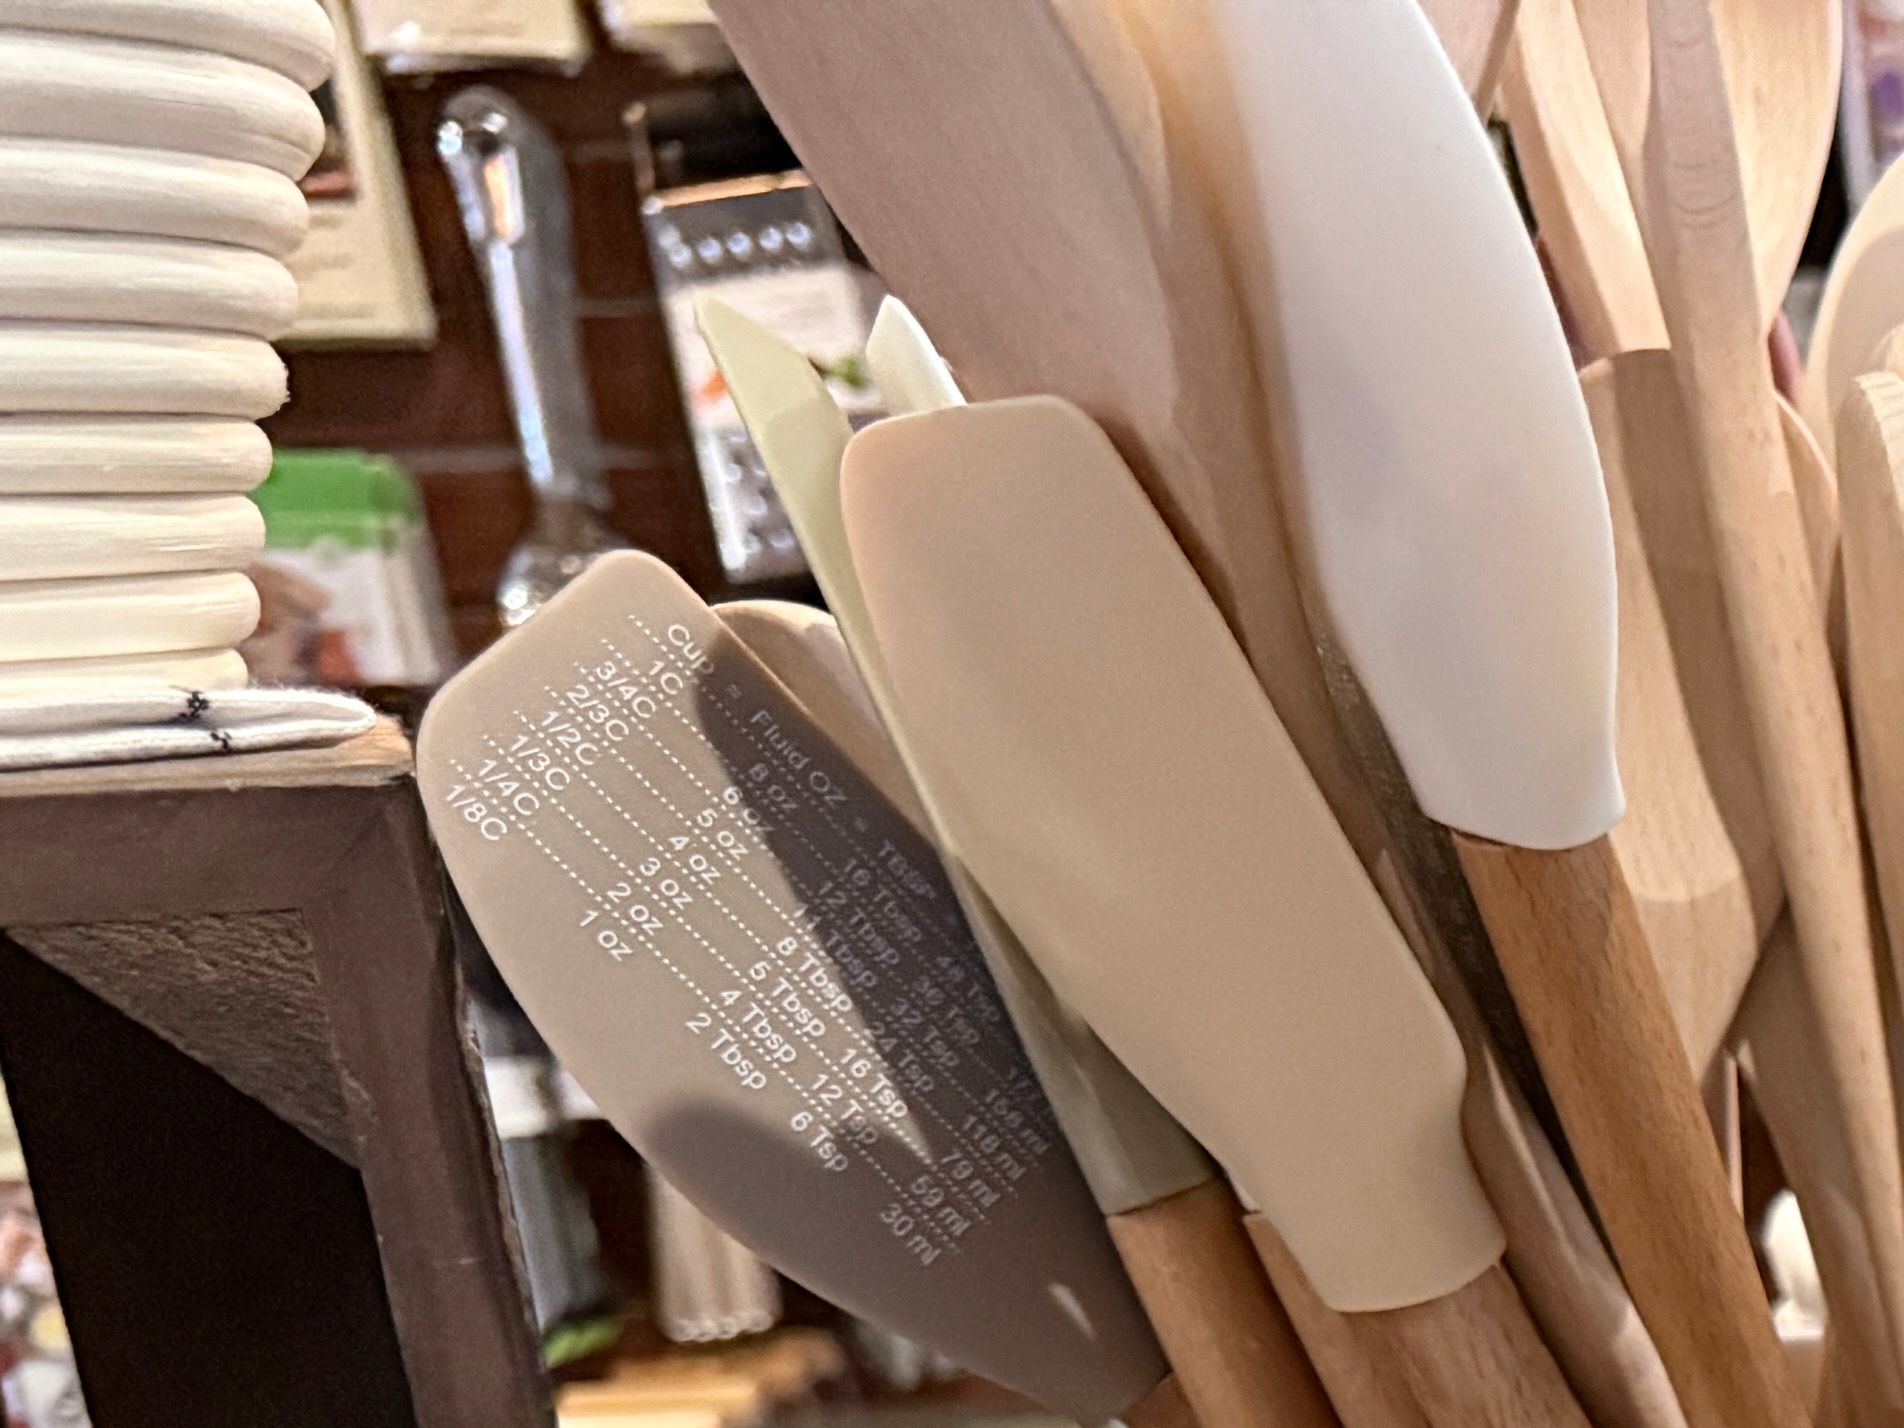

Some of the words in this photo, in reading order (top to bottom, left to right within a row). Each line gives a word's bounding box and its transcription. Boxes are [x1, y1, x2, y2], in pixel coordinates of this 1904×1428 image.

[566, 684, 630, 742] 2/3C
[696, 808, 718, 828] 5
[716, 830, 749, 861] oz
[595, 660, 657, 719] 3/4C
[722, 786, 739, 805] 6
[649, 660, 684, 695] 1C
[767, 784, 798, 810] oz
[667, 624, 714, 673] Cup
[750, 710, 811, 770] Fluid
[809, 770, 848, 807] OZ
[445, 784, 508, 841] 1/8C
[579, 910, 599, 927] 1
[597, 930, 633, 962] oz
[685, 1012, 712, 1034] 2
[710, 1027, 767, 1090] Tbsp
[790, 1111, 814, 1132] 6
[810, 1124, 848, 1171] Tsp
[880, 1203, 914, 1236] 30
[906, 1235, 942, 1266] ml
[478, 759, 540, 816] 1/4C
[606, 882, 632, 903] 2
[629, 904, 664, 936] oz
[719, 990, 742, 1006] 4
[742, 1002, 797, 1063] Tbsp
[812, 1073, 843, 1106] 12
[840, 1098, 876, 1143] Tsp
[911, 1174, 944, 1207] 59
[937, 1206, 971, 1236] ml
[510, 734, 571, 791] 1/3C
[639, 857, 661, 876] 3
[660, 878, 693, 910] oz
[749, 961, 772, 981] 5
[772, 976, 826, 1037] Tbsp
[840, 1048, 872, 1078] 16
[870, 1072, 908, 1118] Tsp
[941, 1148, 974, 1180] 79
[968, 1179, 1001, 1208] ml
[541, 711, 602, 766] 1/2C
[668, 836, 690, 851] 4
[688, 854, 721, 885] oz
[776, 936, 798, 956] 8
[799, 951, 853, 1012] Tbsp
[898, 1049, 934, 1092] Tsp
[995, 1152, 1027, 1180] ml
